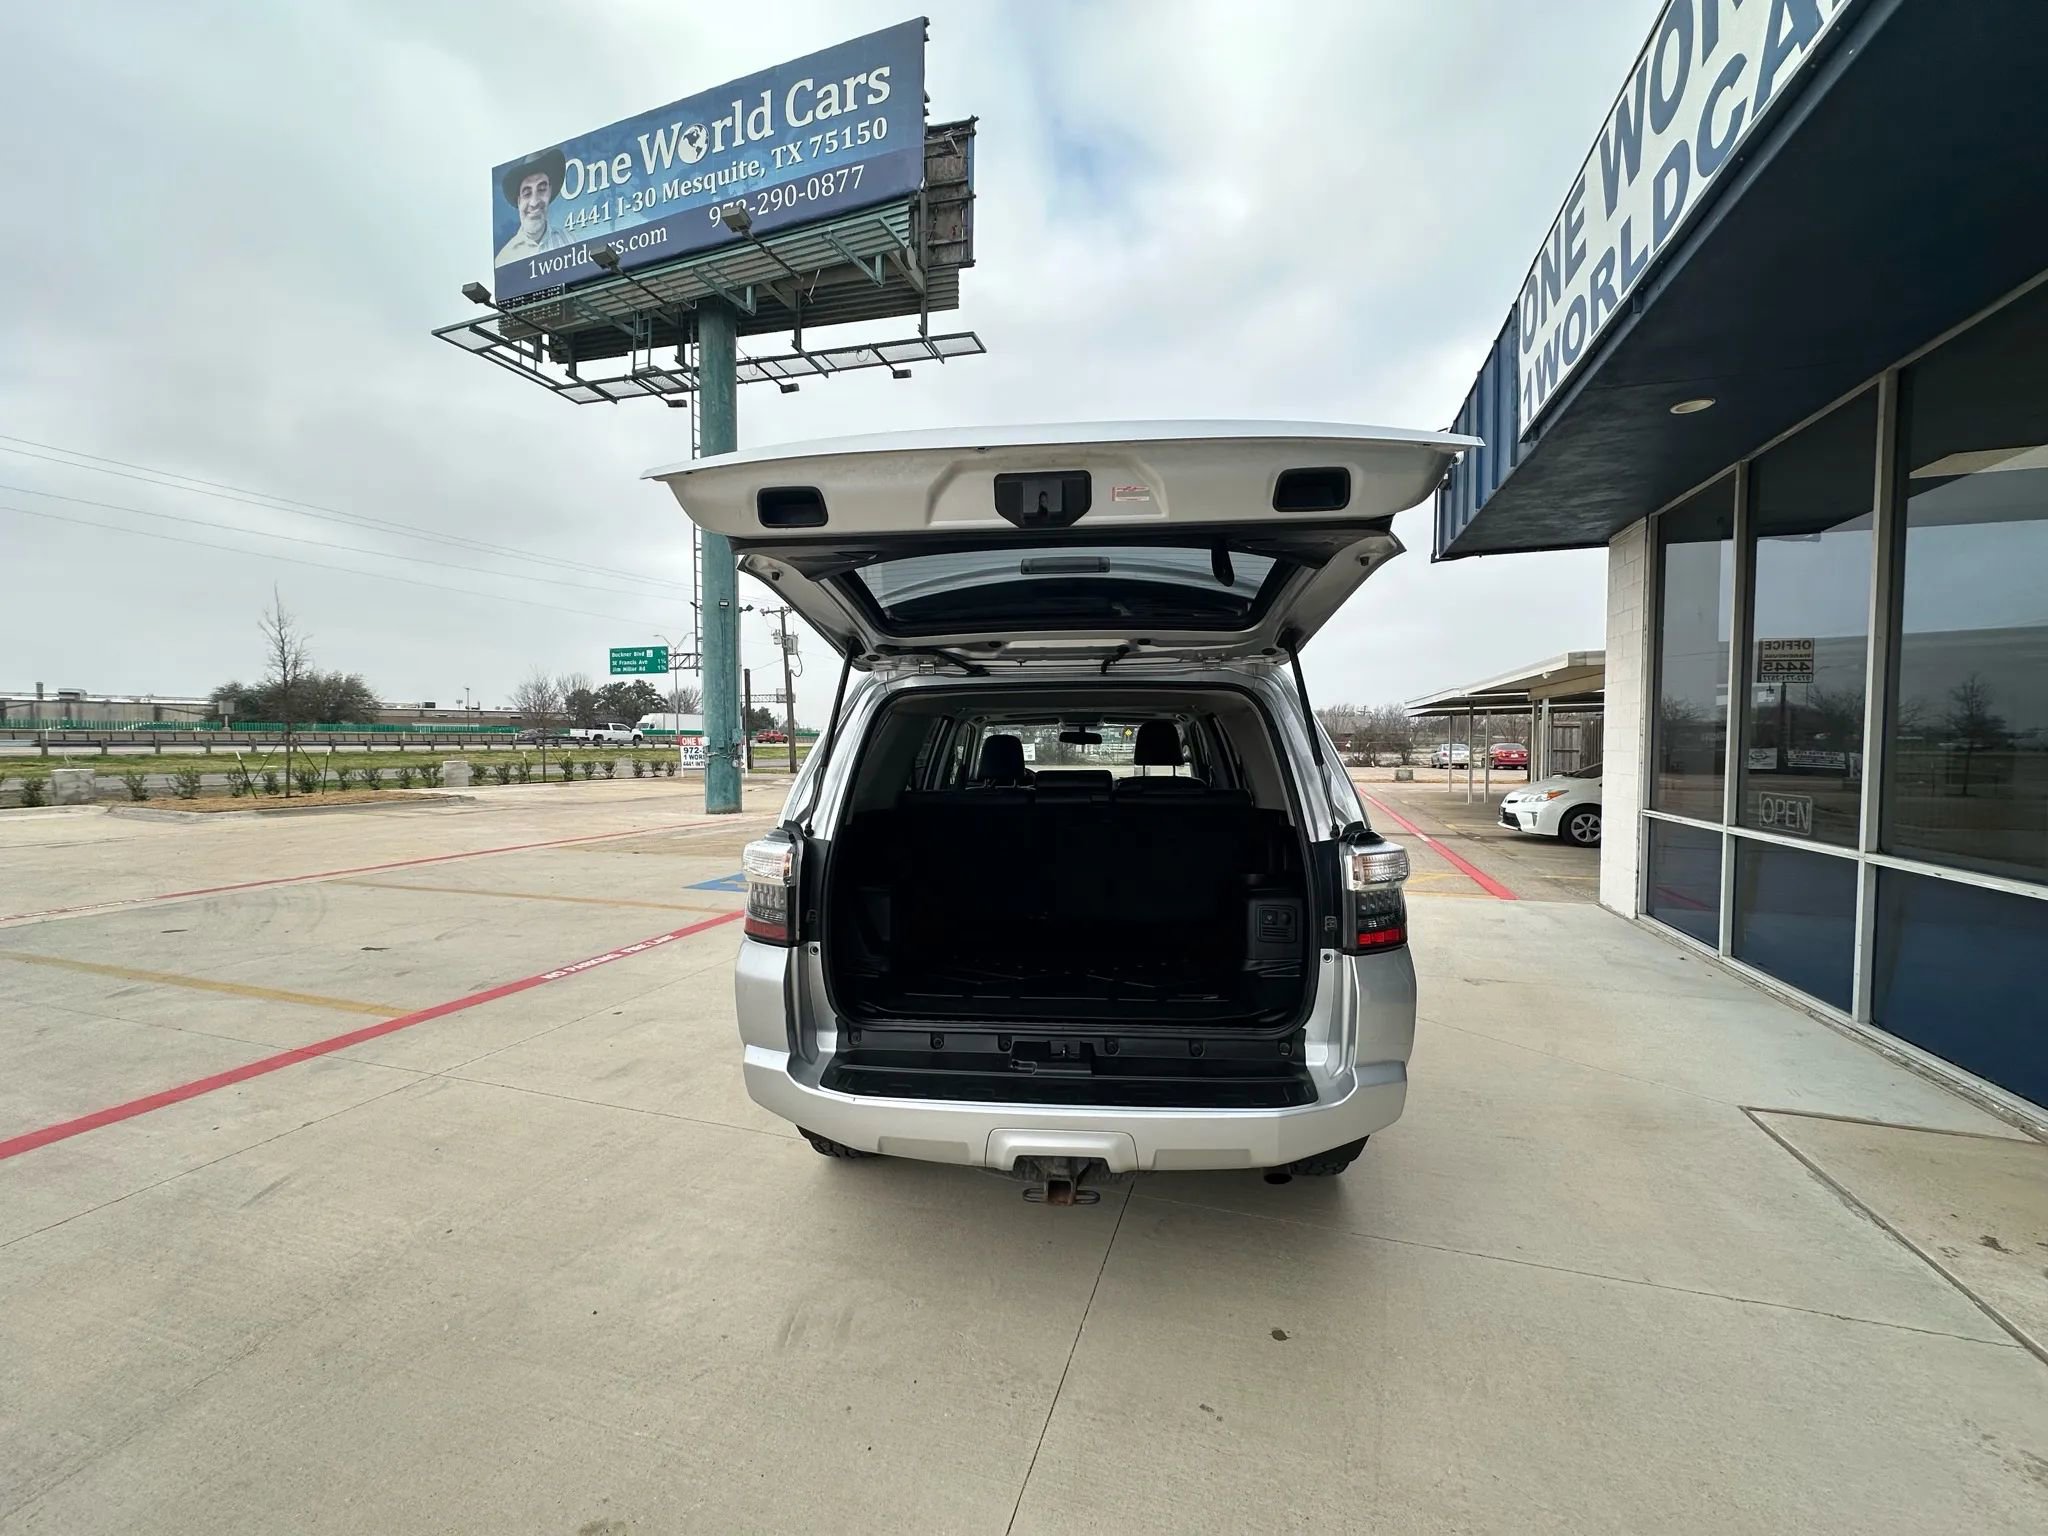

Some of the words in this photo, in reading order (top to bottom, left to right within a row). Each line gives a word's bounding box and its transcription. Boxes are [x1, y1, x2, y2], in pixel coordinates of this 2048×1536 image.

[560, 152, 632, 200] One
[637, 89, 775, 175] World
[785, 66, 891, 128] Cars
[564, 201, 612, 231] 4441
[616, 187, 658, 217] I-30
[662, 158, 766, 204] Mesquite,
[771, 141, 804, 170] TX
[809, 117, 889, 159] 75150
[528, 226, 668, 279] 1worldcrs.com
[1522, 172, 1587, 355] ONE
[1523, 0, 1842, 422] 1WORLDCA
[682, 736, 697, 746] ONE
[1761, 796, 1810, 831] OPEN
